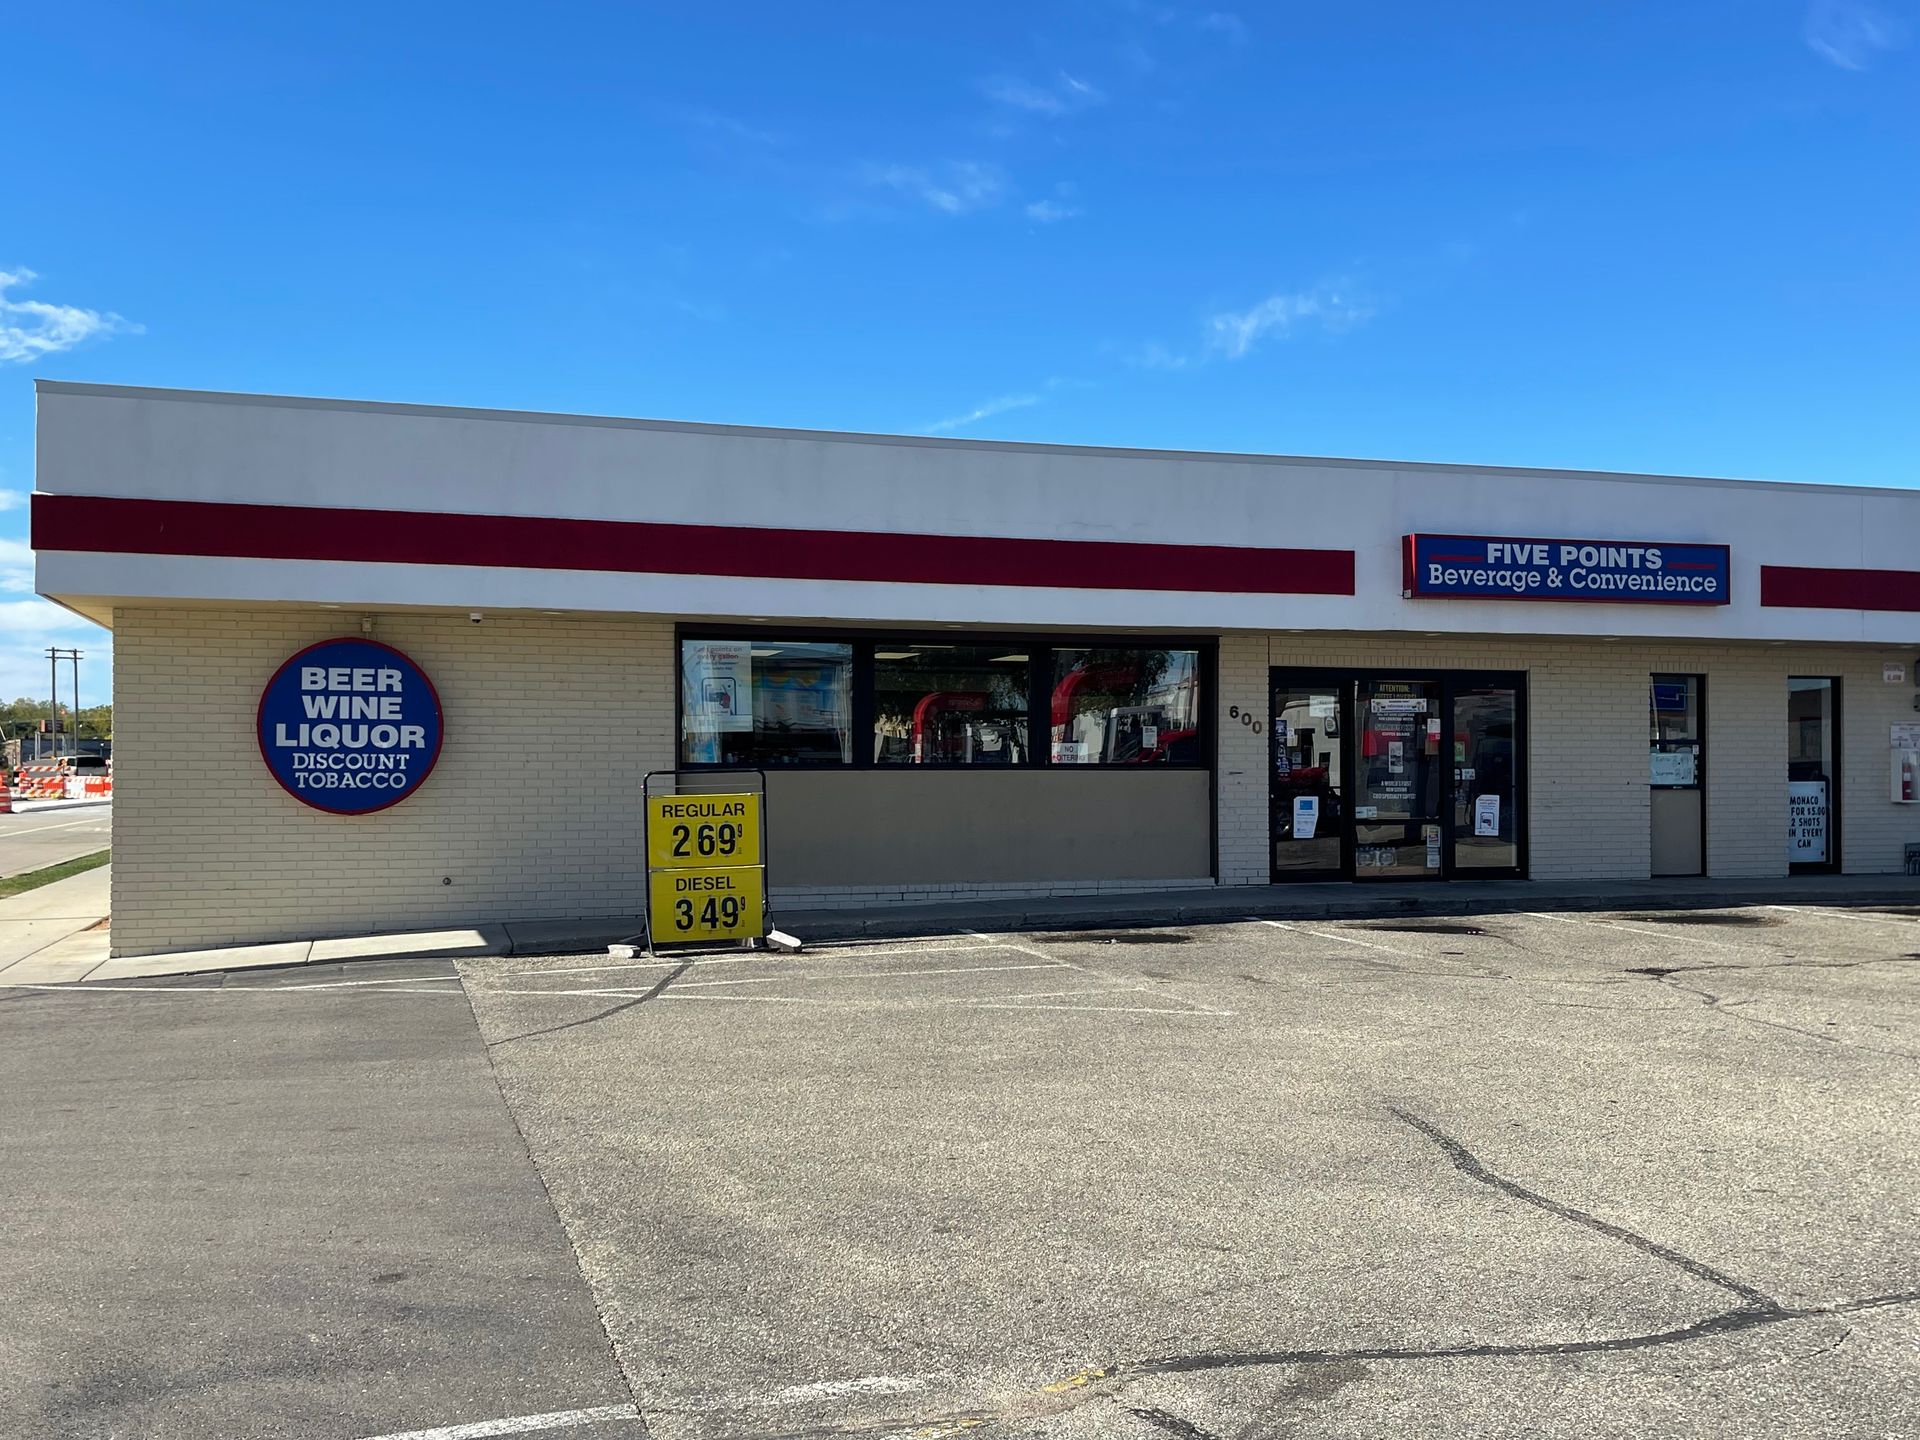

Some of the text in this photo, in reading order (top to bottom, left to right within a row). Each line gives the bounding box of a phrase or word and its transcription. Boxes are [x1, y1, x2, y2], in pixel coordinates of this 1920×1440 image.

[1487, 543, 1663, 570] FIVE POINTS
[1428, 563, 1718, 593] Beverage & Convenience
[301, 667, 403, 692] BEER
[302, 695, 403, 720] WINE
[1229, 705, 1263, 735] 600
[276, 723, 426, 749] LIQUOR
[292, 753, 409, 770] DISCOUNT
[295, 772, 407, 789] TOBACCO
[1790, 796, 1819, 805] MONACO
[662, 803, 745, 818] REGULAR
[1791, 807, 1825, 816] FOR $5.00
[1791, 818, 1820, 827] 2 SHOTS
[1802, 828, 1823, 838] EVERY
[1797, 839, 1811, 848] CAN
[676, 876, 736, 892] DIESEL
